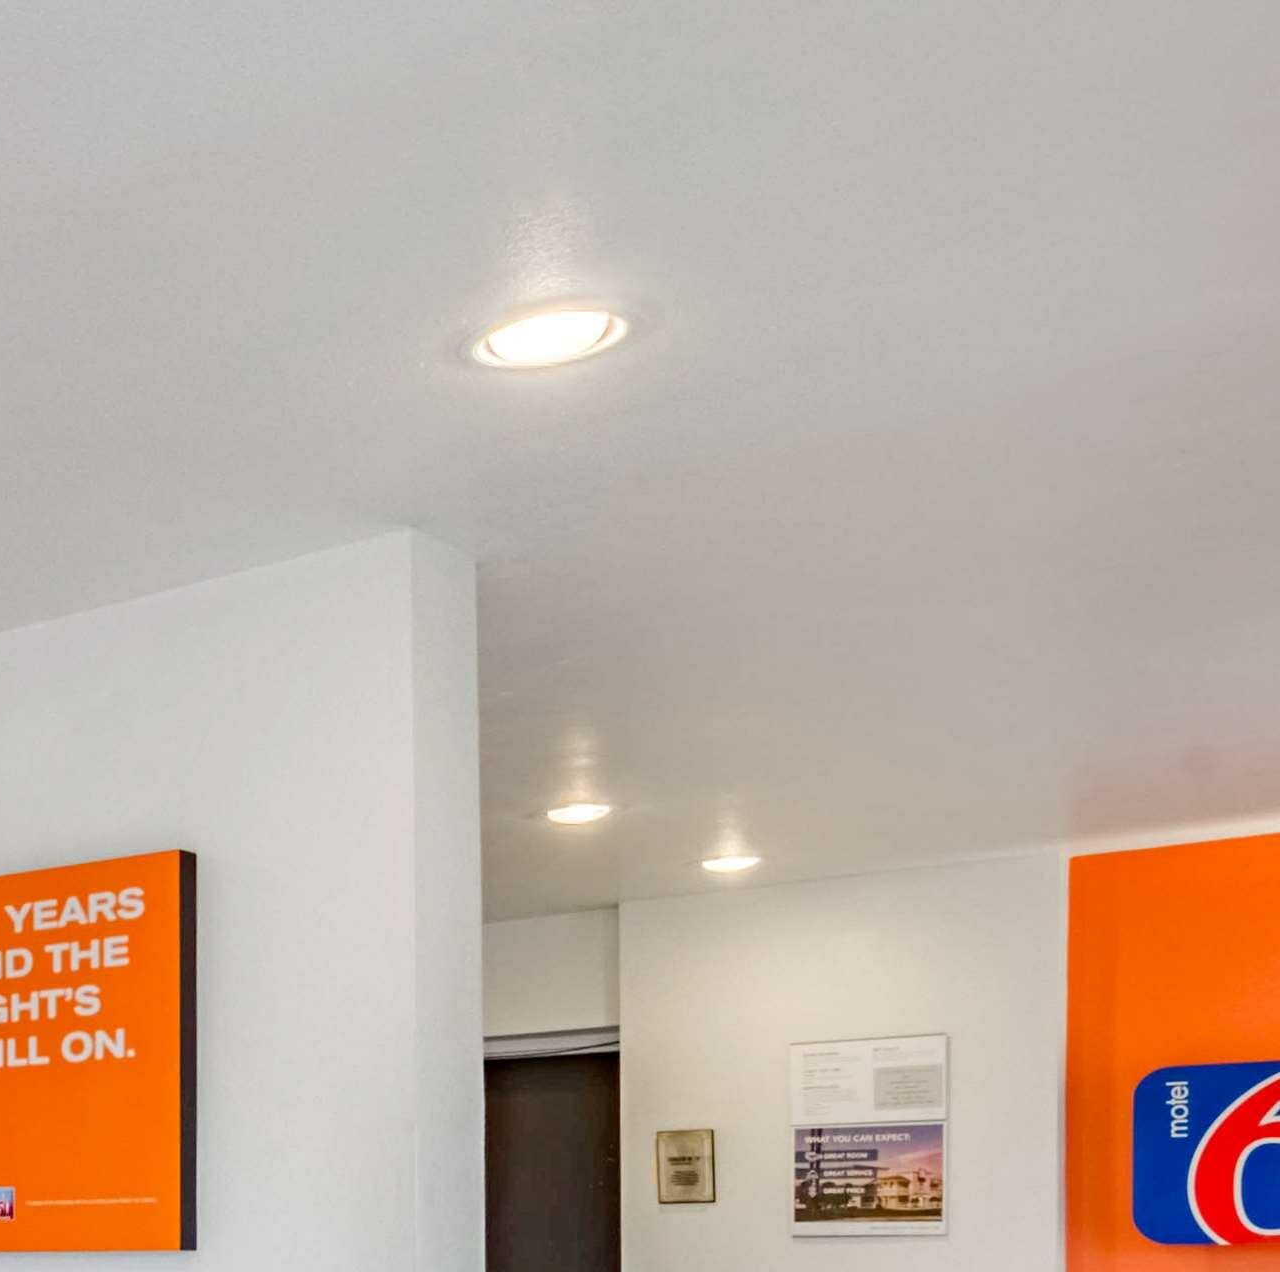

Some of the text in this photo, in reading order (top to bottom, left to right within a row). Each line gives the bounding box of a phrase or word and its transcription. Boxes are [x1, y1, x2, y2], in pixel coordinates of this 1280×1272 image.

[4, 886, 145, 934] YEARS
[44, 935, 130, 973] THE
[61, 1028, 136, 1063] ON.
[1165, 1081, 1189, 1138] motel
[832, 1134, 851, 1144] YOU
[853, 1133, 873, 1143] CAN
